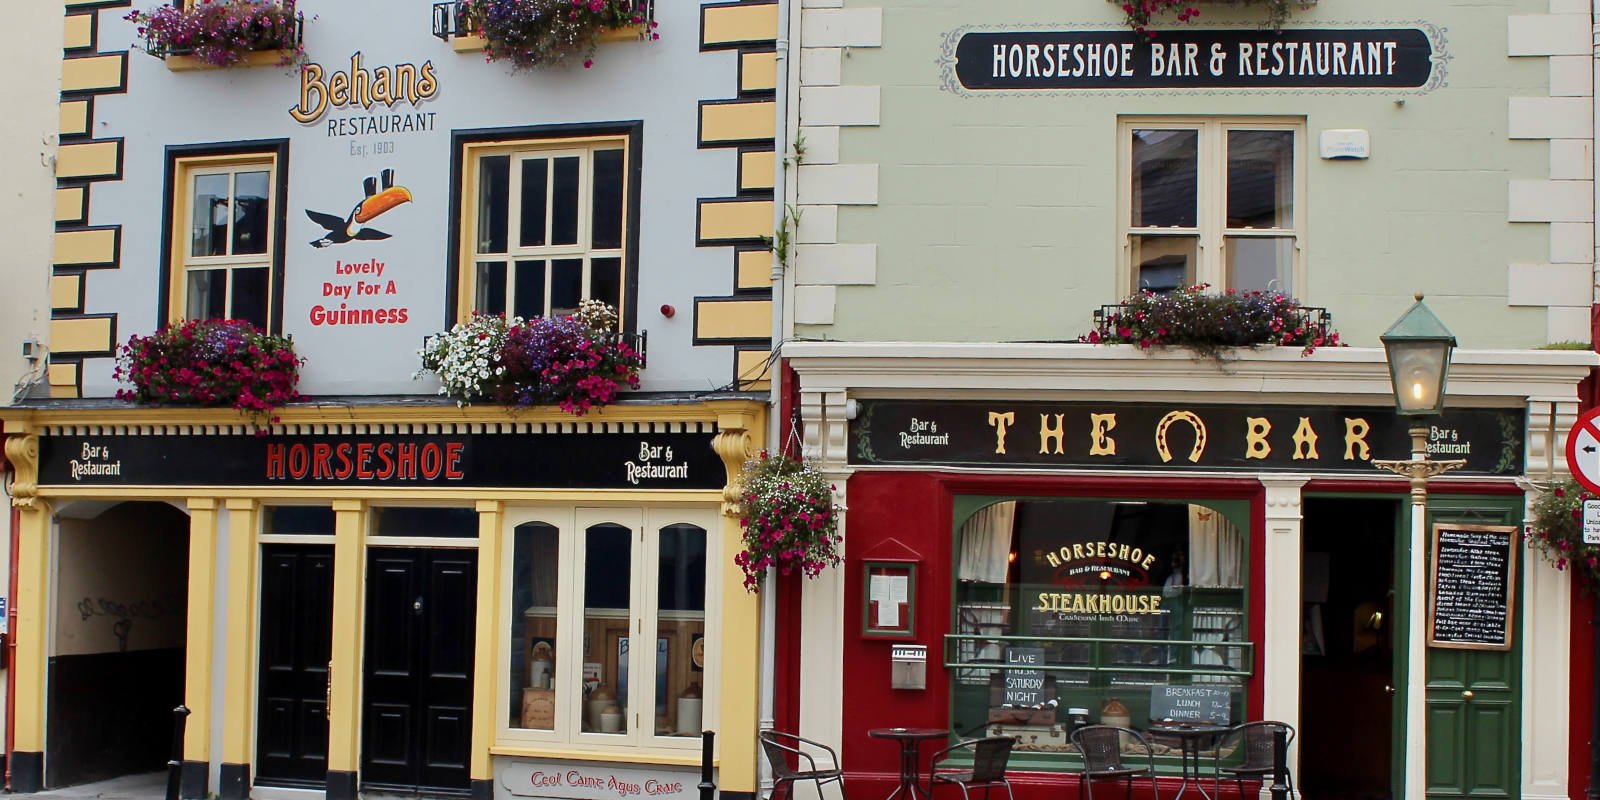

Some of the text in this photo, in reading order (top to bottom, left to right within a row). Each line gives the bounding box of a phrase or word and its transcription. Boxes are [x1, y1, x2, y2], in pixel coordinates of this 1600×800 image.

[992, 41, 1397, 78] HORSESHOE BAR & RESTAURANT
[288, 51, 439, 125] Behans
[328, 112, 437, 137] RESTAURANT
[373, 141, 395, 155] 1903
[336, 258, 385, 277] Lovely
[323, 280, 397, 299] Day For A
[309, 303, 409, 326] Guinness
[910, 417, 937, 434] Bar &
[1430, 425, 1458, 441] Bar &
[899, 431, 950, 449] Restaurant
[988, 411, 1371, 460] THE BAR
[82, 442, 109, 461] Bar &
[638, 441, 673, 461] Bar &
[70, 460, 121, 481] Restaurant
[266, 442, 465, 480] HORSESHOE
[624, 461, 689, 484] Restaurant
[1046, 541, 1156, 571] HORSESHOE
[1038, 593, 1163, 615] STEAKHOUSE
[1006, 677, 1044, 689] SATURDAY
[1165, 687, 1212, 697] BREAKFAST
[1006, 692, 1037, 702] NIGHT
[1176, 699, 1200, 707] LUNCH
[1170, 708, 1200, 719] DINNER
[531, 771, 563, 787] Ceol
[607, 775, 641, 796] Agus
